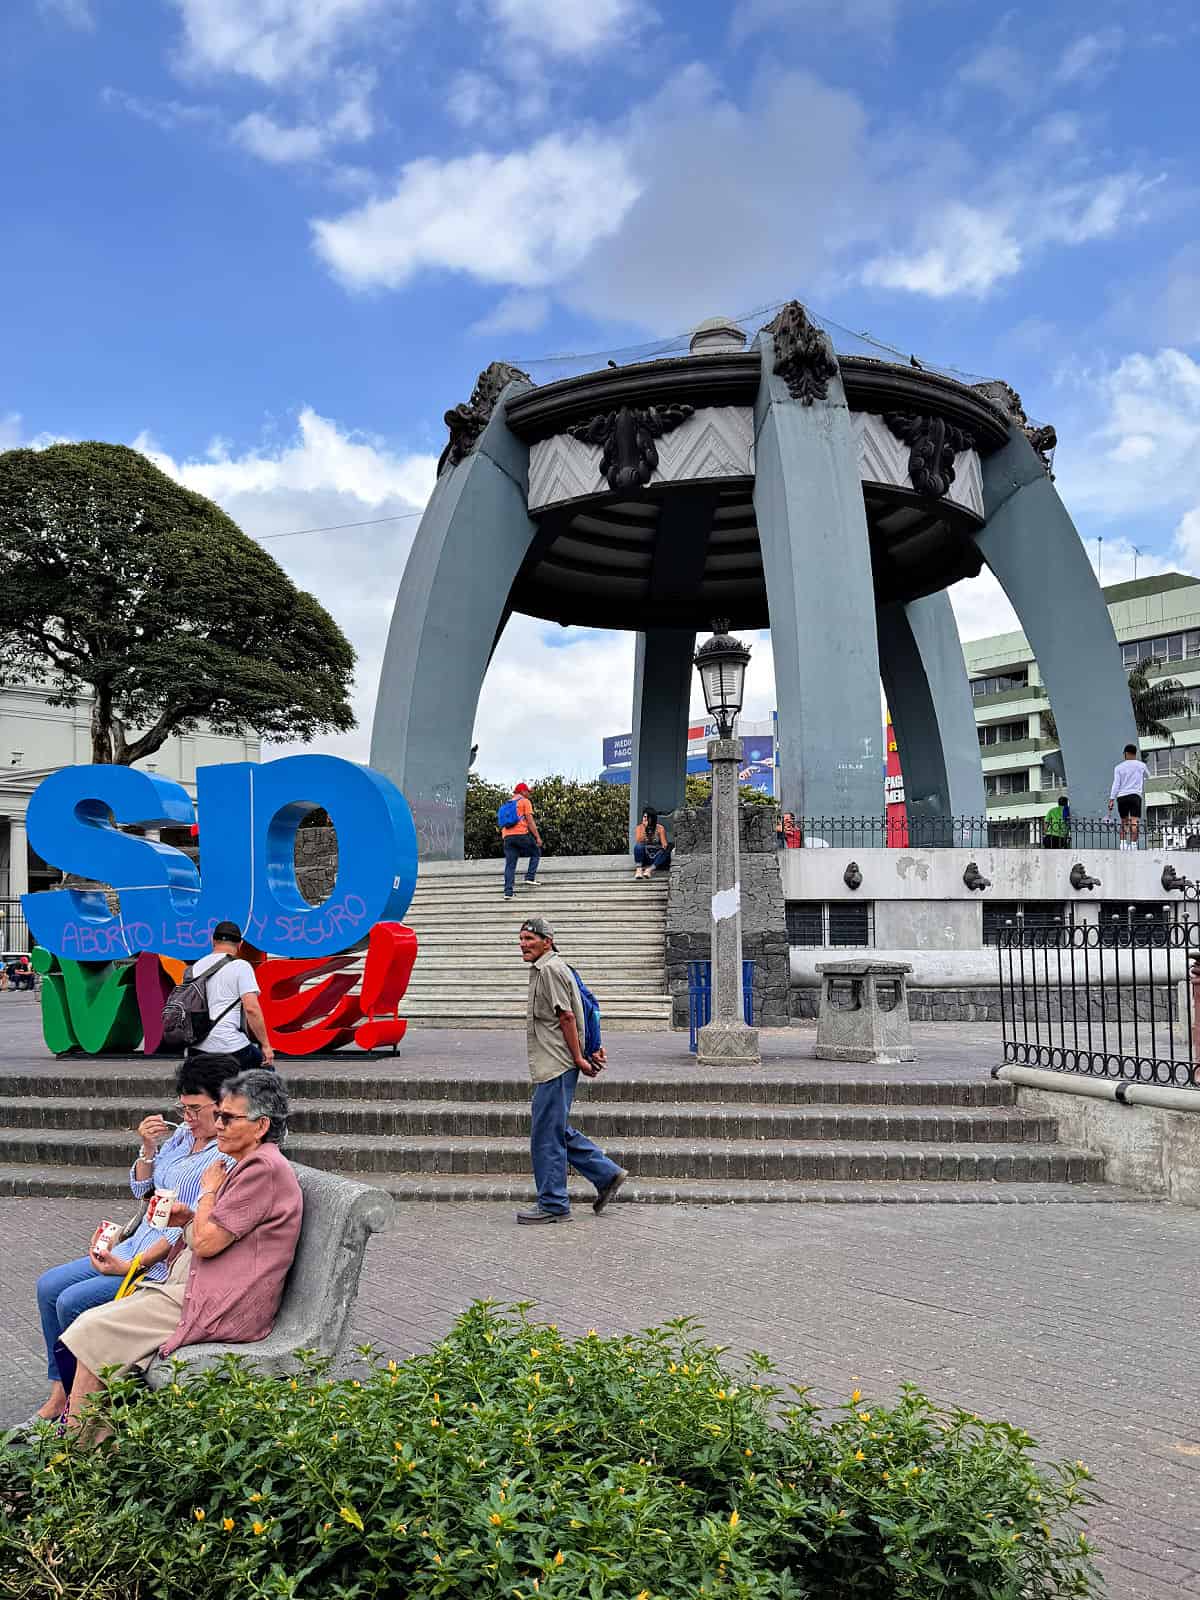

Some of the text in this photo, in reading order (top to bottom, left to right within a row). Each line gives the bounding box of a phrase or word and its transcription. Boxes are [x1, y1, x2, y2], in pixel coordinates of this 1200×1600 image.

[20, 754, 418, 961] SJO
[62, 895, 366, 953] ABORTO LEGA Y SEGURO
